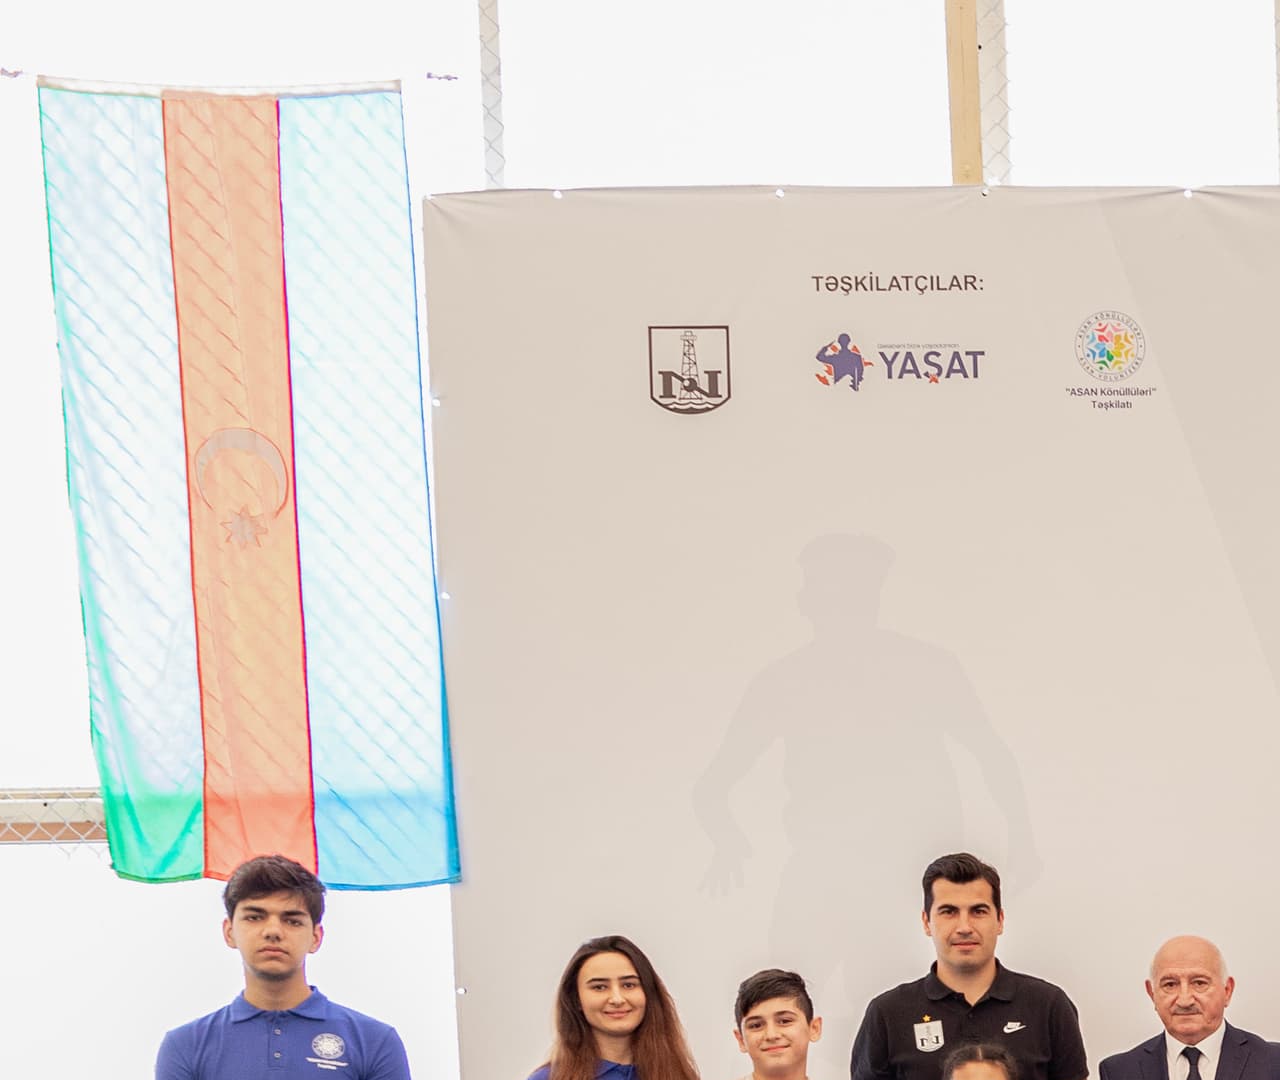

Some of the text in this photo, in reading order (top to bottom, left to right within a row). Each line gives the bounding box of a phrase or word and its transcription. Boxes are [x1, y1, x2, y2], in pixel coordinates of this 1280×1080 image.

[811, 272, 984, 295] TƏŞKİLATÇILAR:
[878, 350, 986, 384] YAŞAT
[1091, 400, 1132, 411] Təşkilatı
